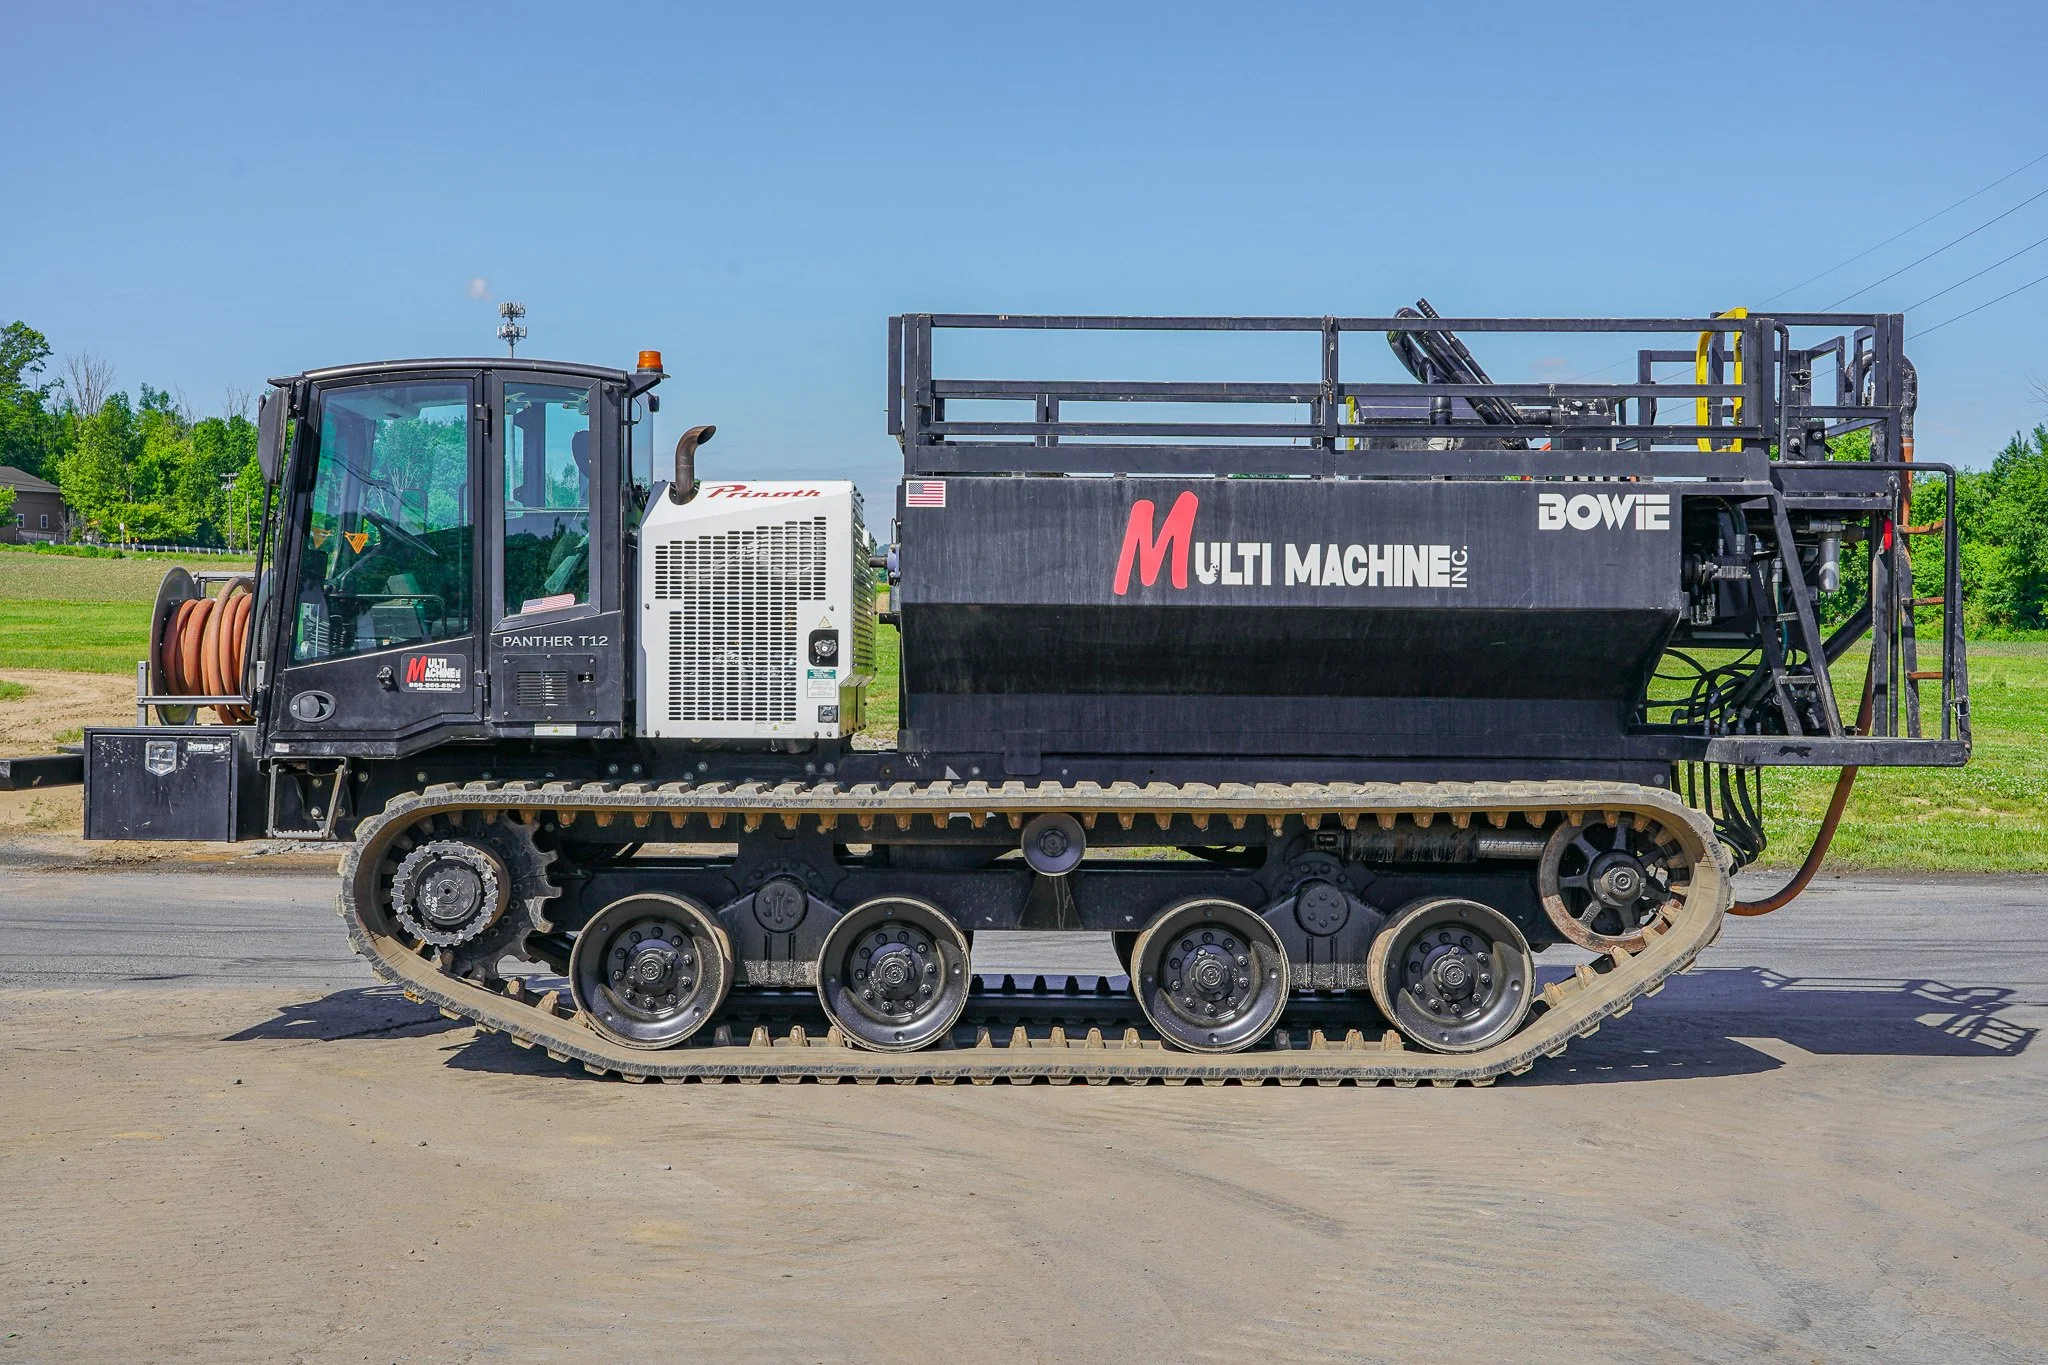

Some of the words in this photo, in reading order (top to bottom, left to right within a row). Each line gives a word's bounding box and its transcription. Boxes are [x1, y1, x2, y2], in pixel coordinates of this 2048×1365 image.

[705, 484, 821, 498] Prinoth
[1538, 493, 1671, 531] BOWIE
[1113, 490, 1273, 596] MULTI
[1285, 543, 1451, 588] MACHINE
[1451, 545, 1469, 588] INC.
[502, 636, 574, 647] PANTHER
[578, 635, 609, 646] T12
